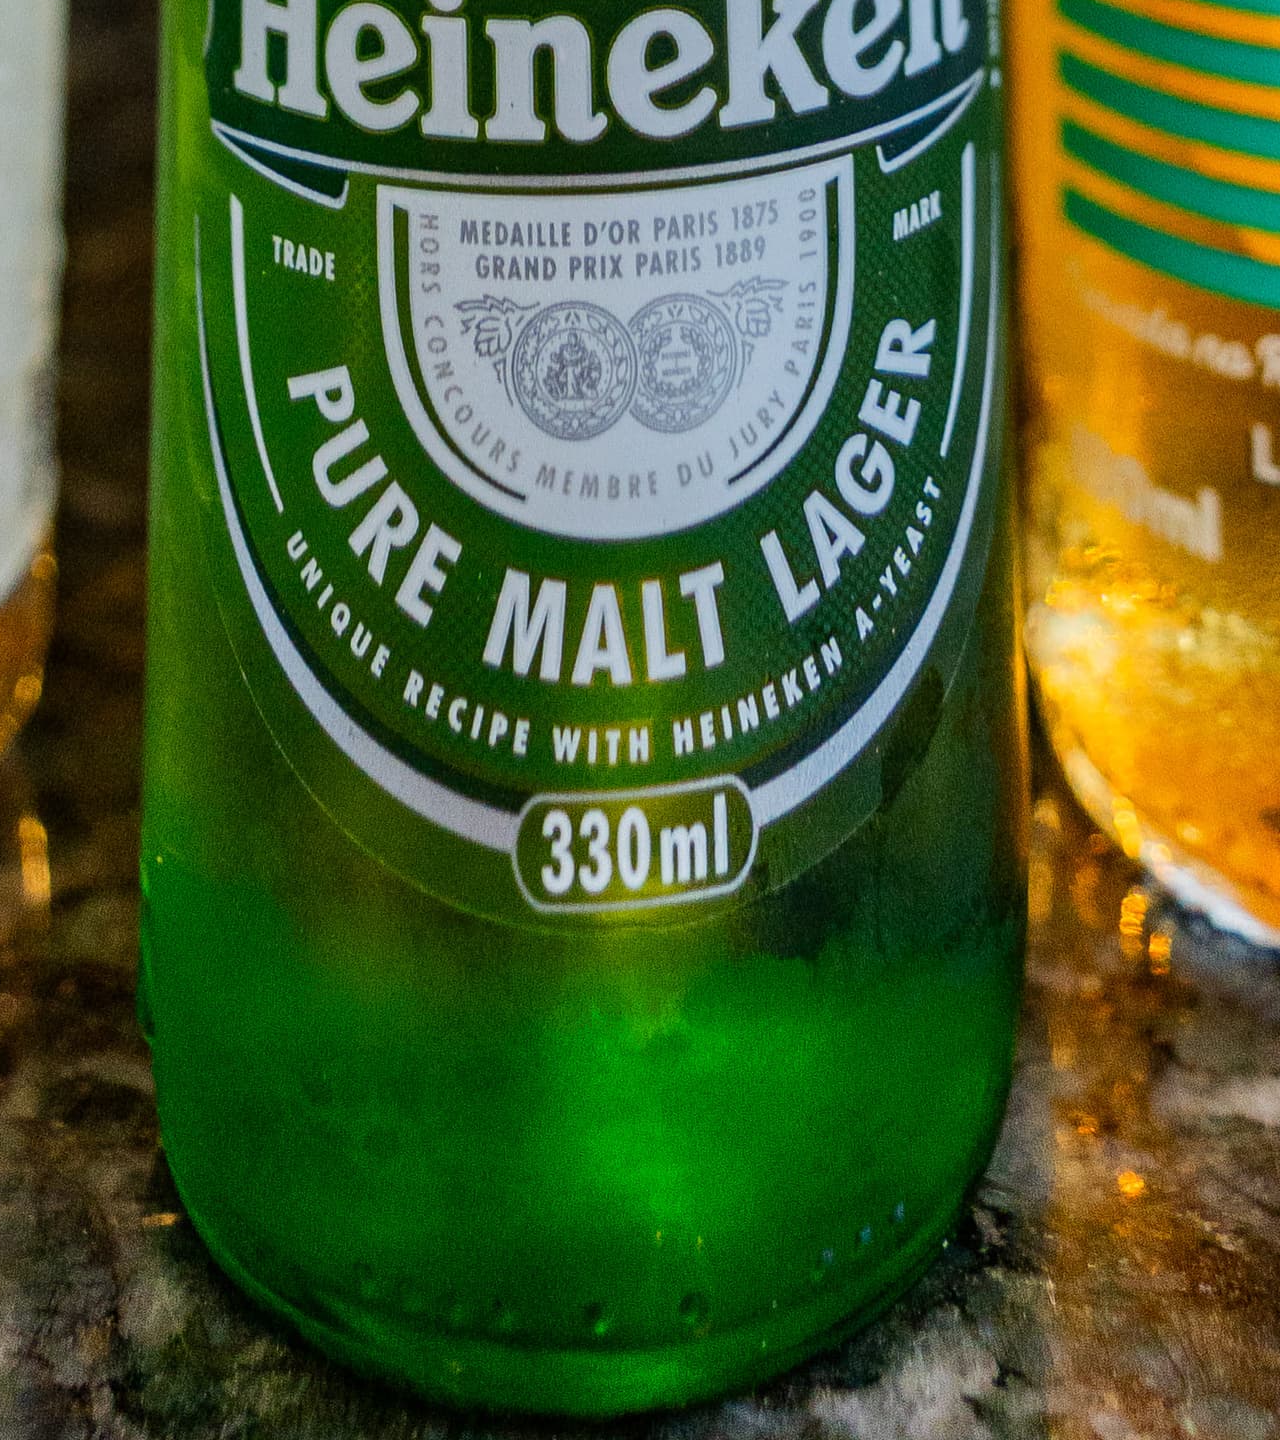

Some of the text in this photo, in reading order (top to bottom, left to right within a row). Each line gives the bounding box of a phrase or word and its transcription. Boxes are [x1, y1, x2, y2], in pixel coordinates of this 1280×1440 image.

[459, 199, 780, 248] MEDAILLE D'OR PARIS 1875
[891, 190, 942, 243] MARK
[272, 234, 336, 281] TRADE
[475, 234, 767, 281] GRAND PRIX PARIS 1889
[419, 186, 817, 501] HORS CONCOURS MEMBRE DU JURY PARIS 1900
[286, 364, 464, 629] PURE
[482, 562, 725, 687] MALT
[759, 317, 938, 626] LAGER
[286, 530, 390, 680] UNIQUE
[403, 668, 532, 757] RECIPE
[551, 722, 651, 766] WITH
[672, 635, 844, 756] HEINEKEN
[854, 473, 943, 642] A-YEAST
[540, 791, 730, 897] 330ml
